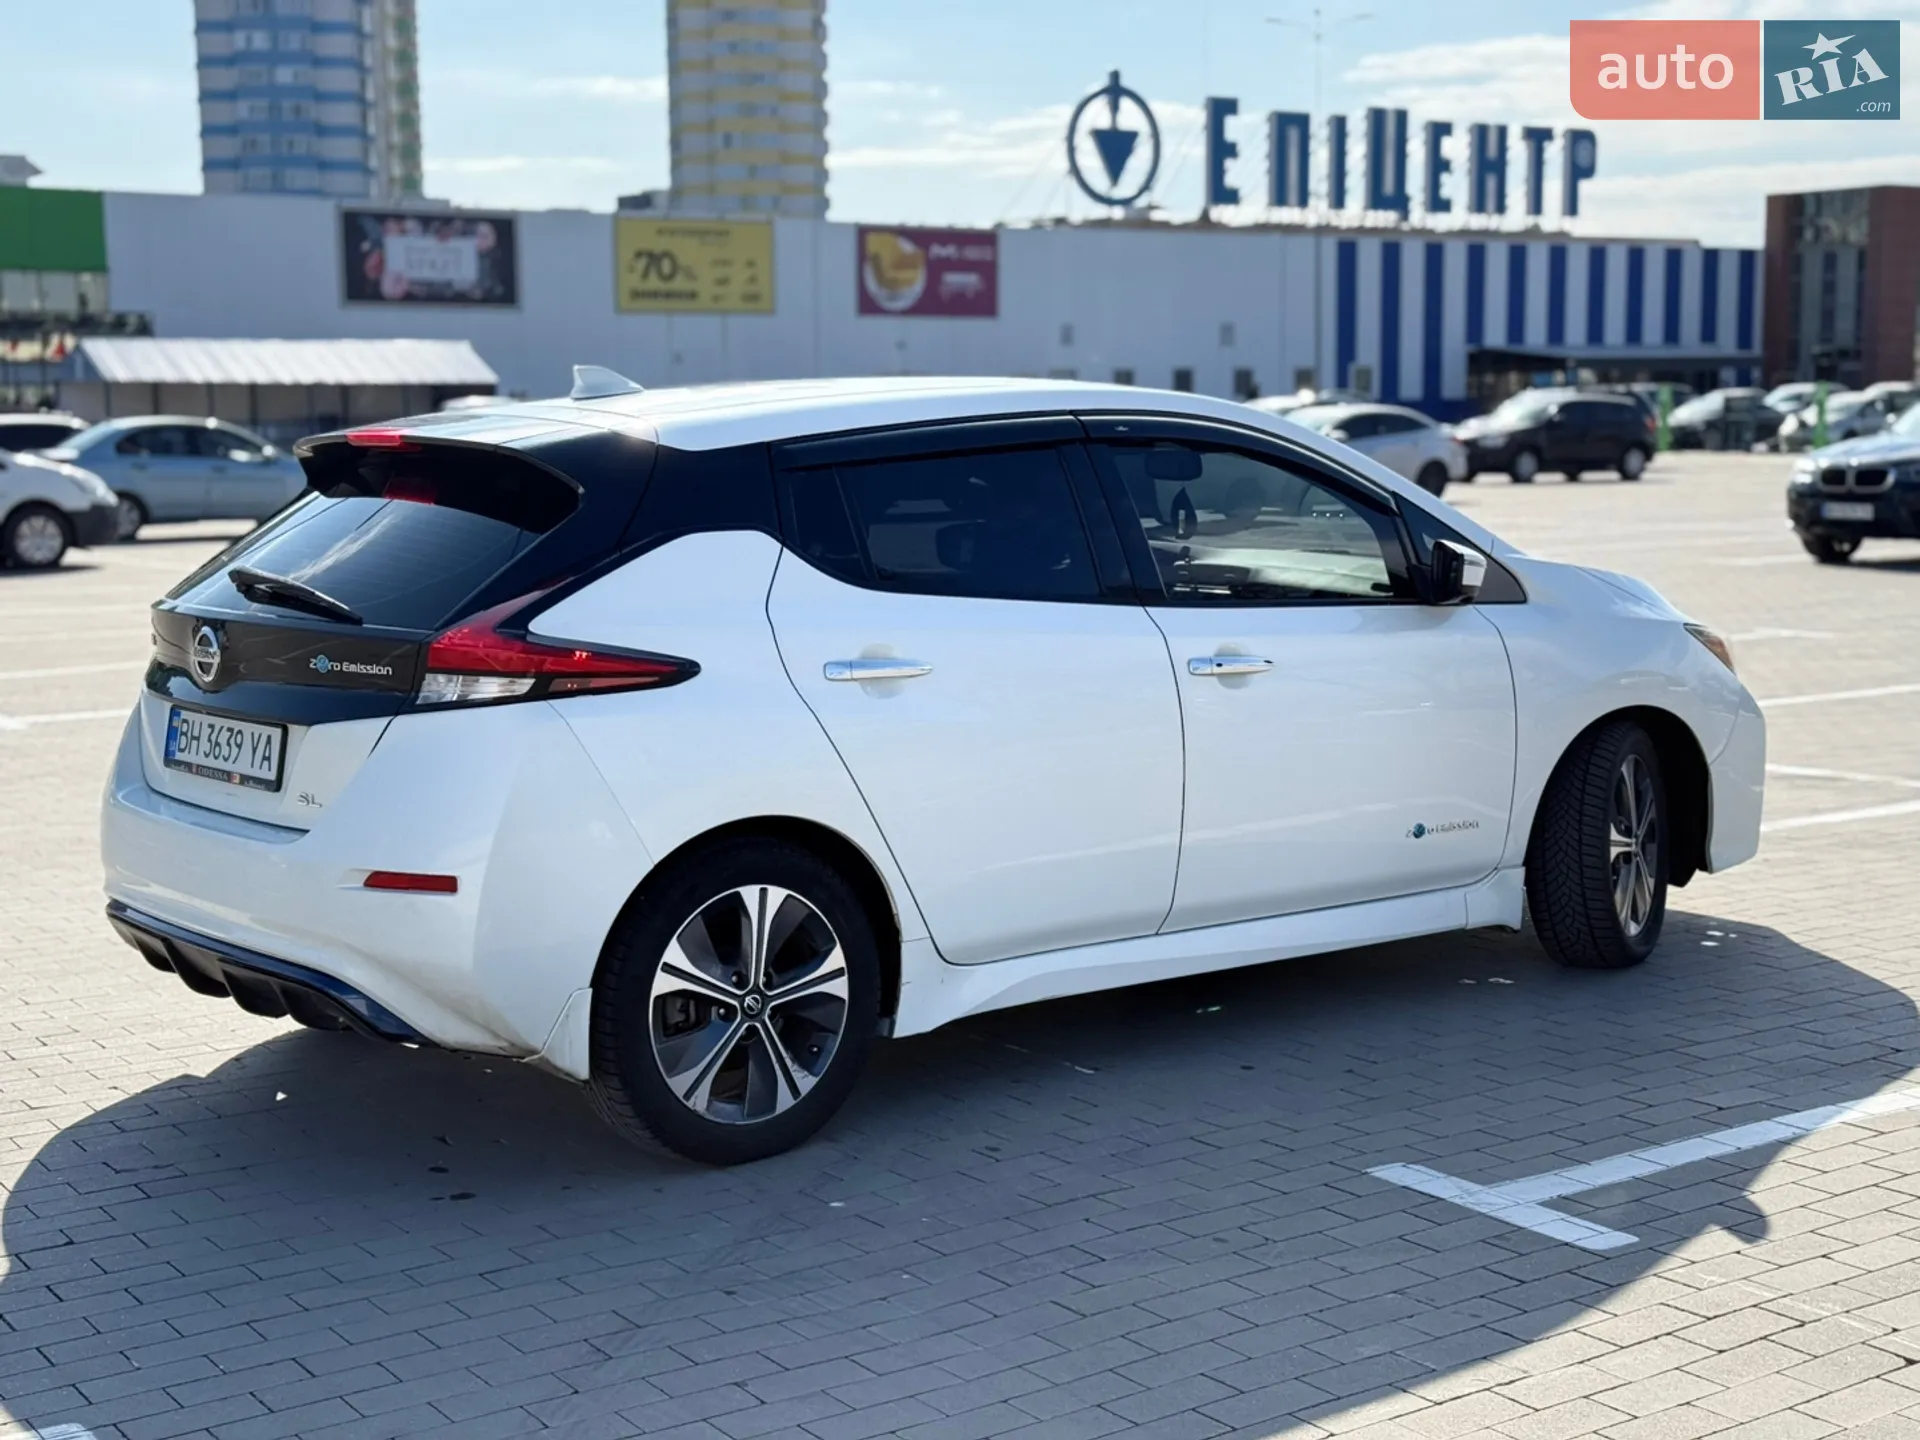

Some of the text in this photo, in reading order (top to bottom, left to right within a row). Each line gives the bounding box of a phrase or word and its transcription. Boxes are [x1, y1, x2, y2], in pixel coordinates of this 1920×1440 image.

[1205, 96, 1597, 220] ЕПІЦЕНТР
[177, 718, 203, 756] BH
[203, 723, 244, 765] 3639
[250, 731, 273, 772] YA
